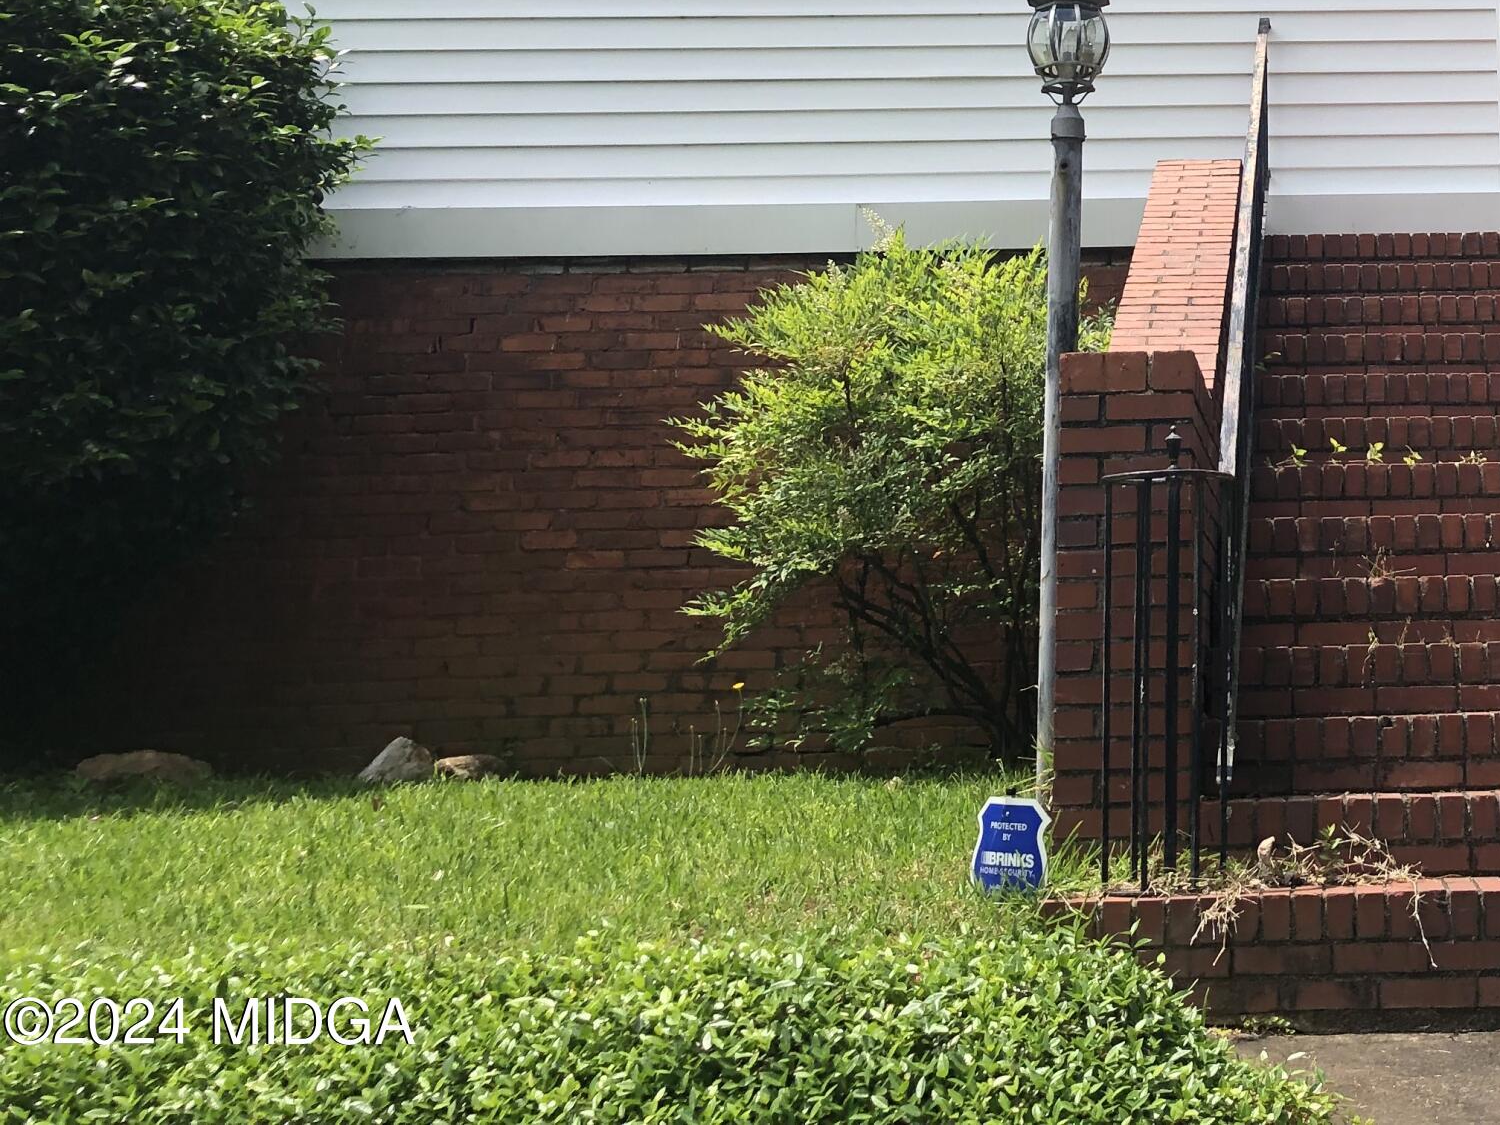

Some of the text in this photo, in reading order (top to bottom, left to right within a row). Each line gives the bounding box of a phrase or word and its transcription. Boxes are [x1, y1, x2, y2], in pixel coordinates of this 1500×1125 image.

[990, 821, 1028, 832] PROTECTED
[1002, 832, 1012, 841] BY
[981, 850, 1035, 869] BRINKS
[980, 866, 998, 875] HOME
